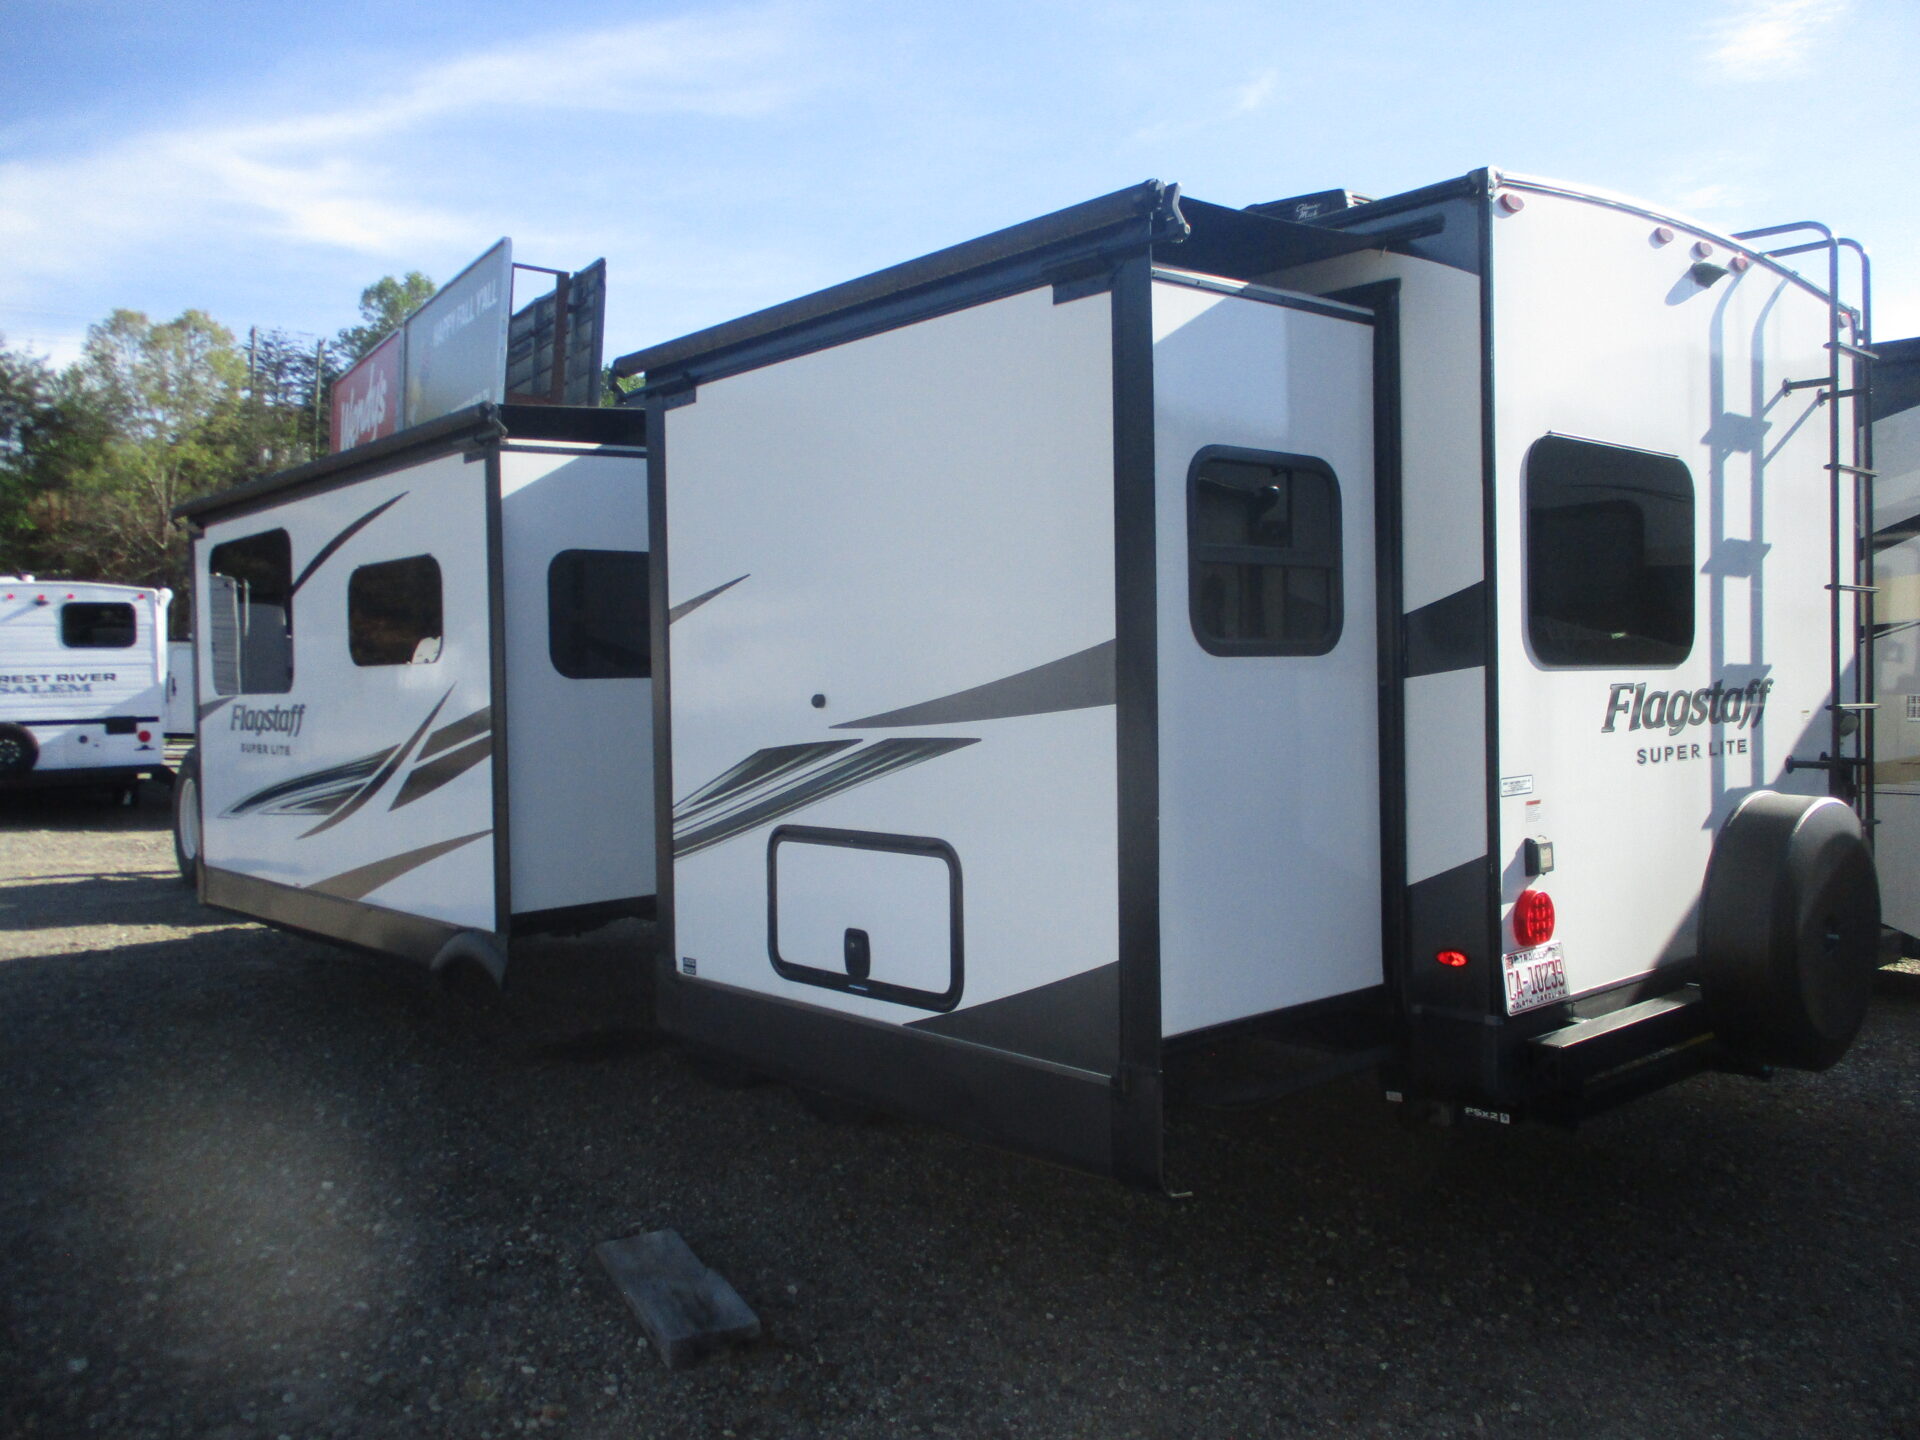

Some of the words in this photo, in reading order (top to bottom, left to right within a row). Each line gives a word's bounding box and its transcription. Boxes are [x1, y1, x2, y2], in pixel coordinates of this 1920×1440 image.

[56, 673, 117, 682] RIVER
[230, 704, 306, 737] Flagstaff
[1600, 677, 1774, 737] Flagstaff
[241, 743, 268, 754] SUPER
[270, 745, 291, 756] LITE
[1636, 743, 1703, 765] SUPER
[1708, 738, 1748, 757] LITE
